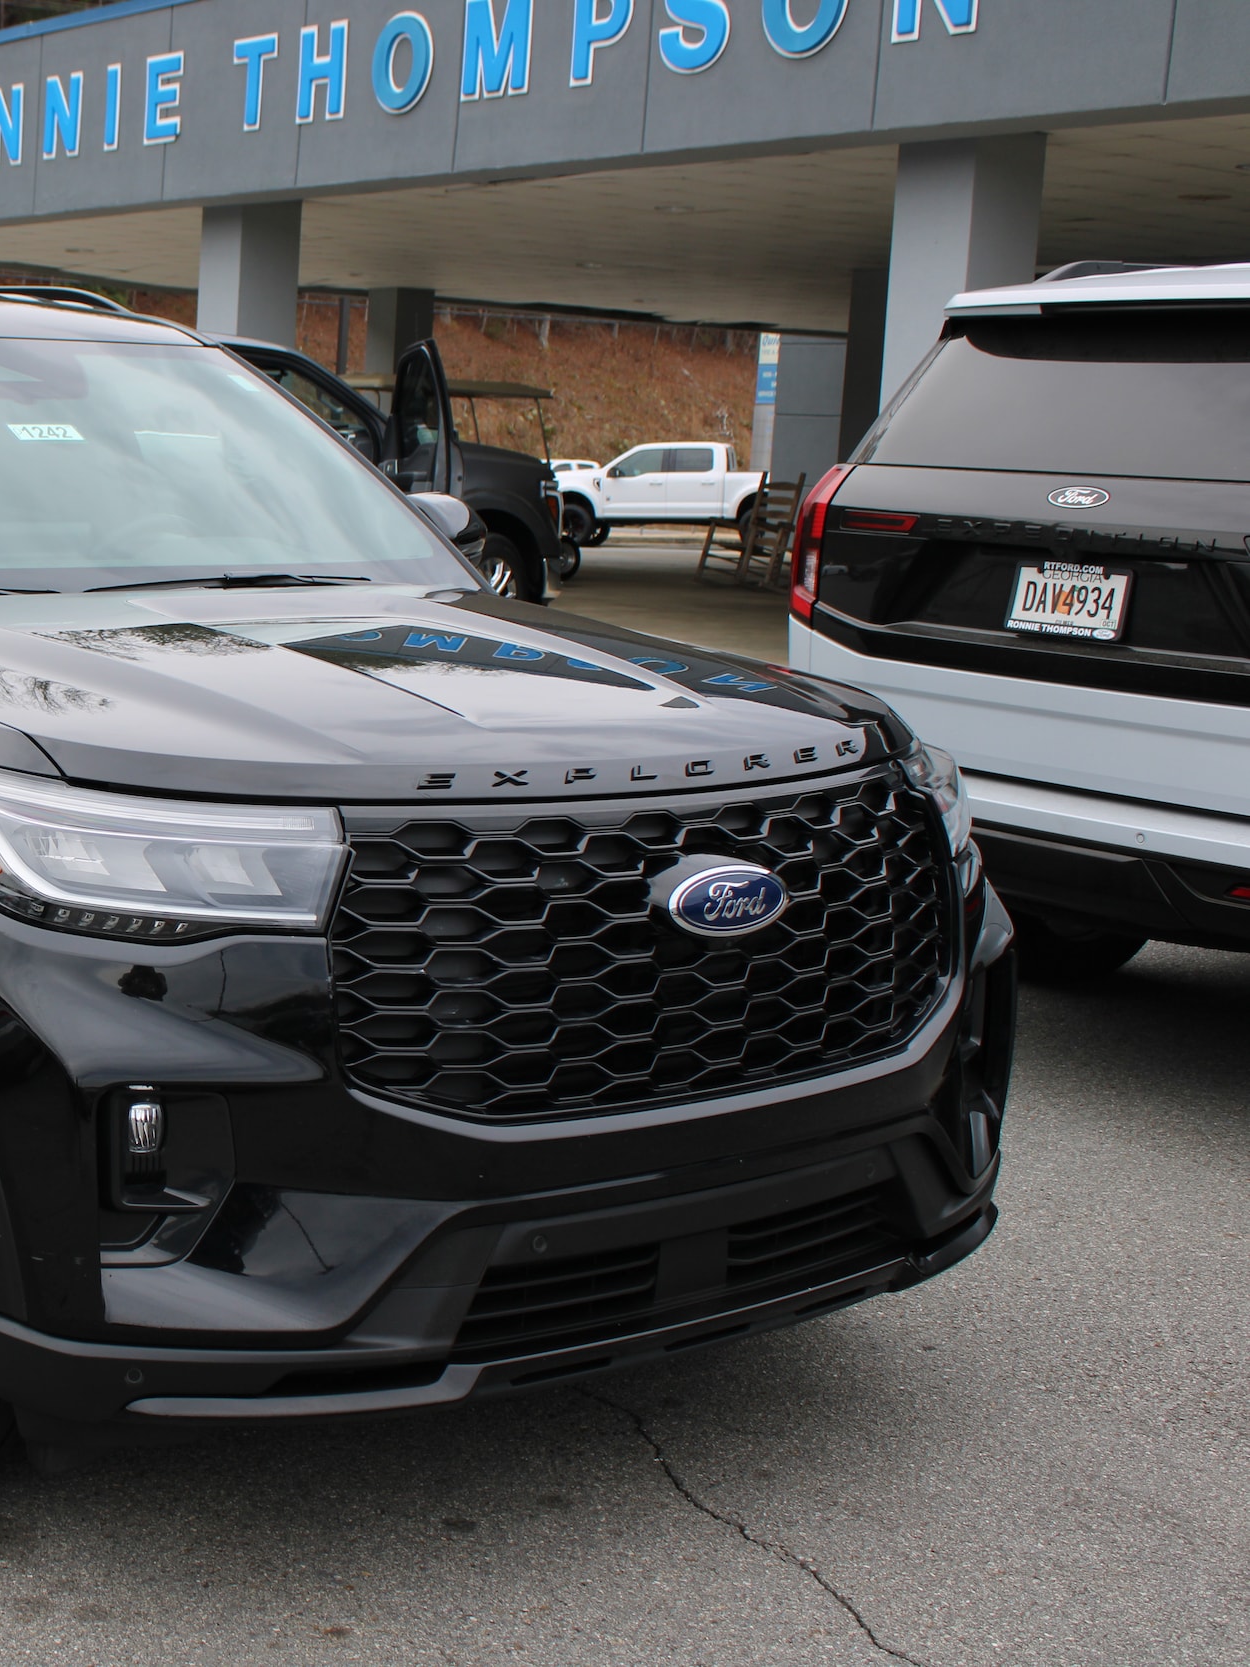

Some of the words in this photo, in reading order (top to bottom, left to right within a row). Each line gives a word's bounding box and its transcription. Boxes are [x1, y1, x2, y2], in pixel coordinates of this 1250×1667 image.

[21, 426, 73, 438] 1242
[1056, 487, 1100, 506] Ford
[1041, 570, 1102, 584] GEORGIA
[1043, 561, 1104, 575] RTFORD.COM
[1021, 580, 1116, 620] DAV4934
[1006, 619, 1040, 632] RONNIE
[1041, 623, 1092, 637] THOMPSON
[415, 739, 859, 790] EXPLORER
[703, 880, 767, 922] Ford
